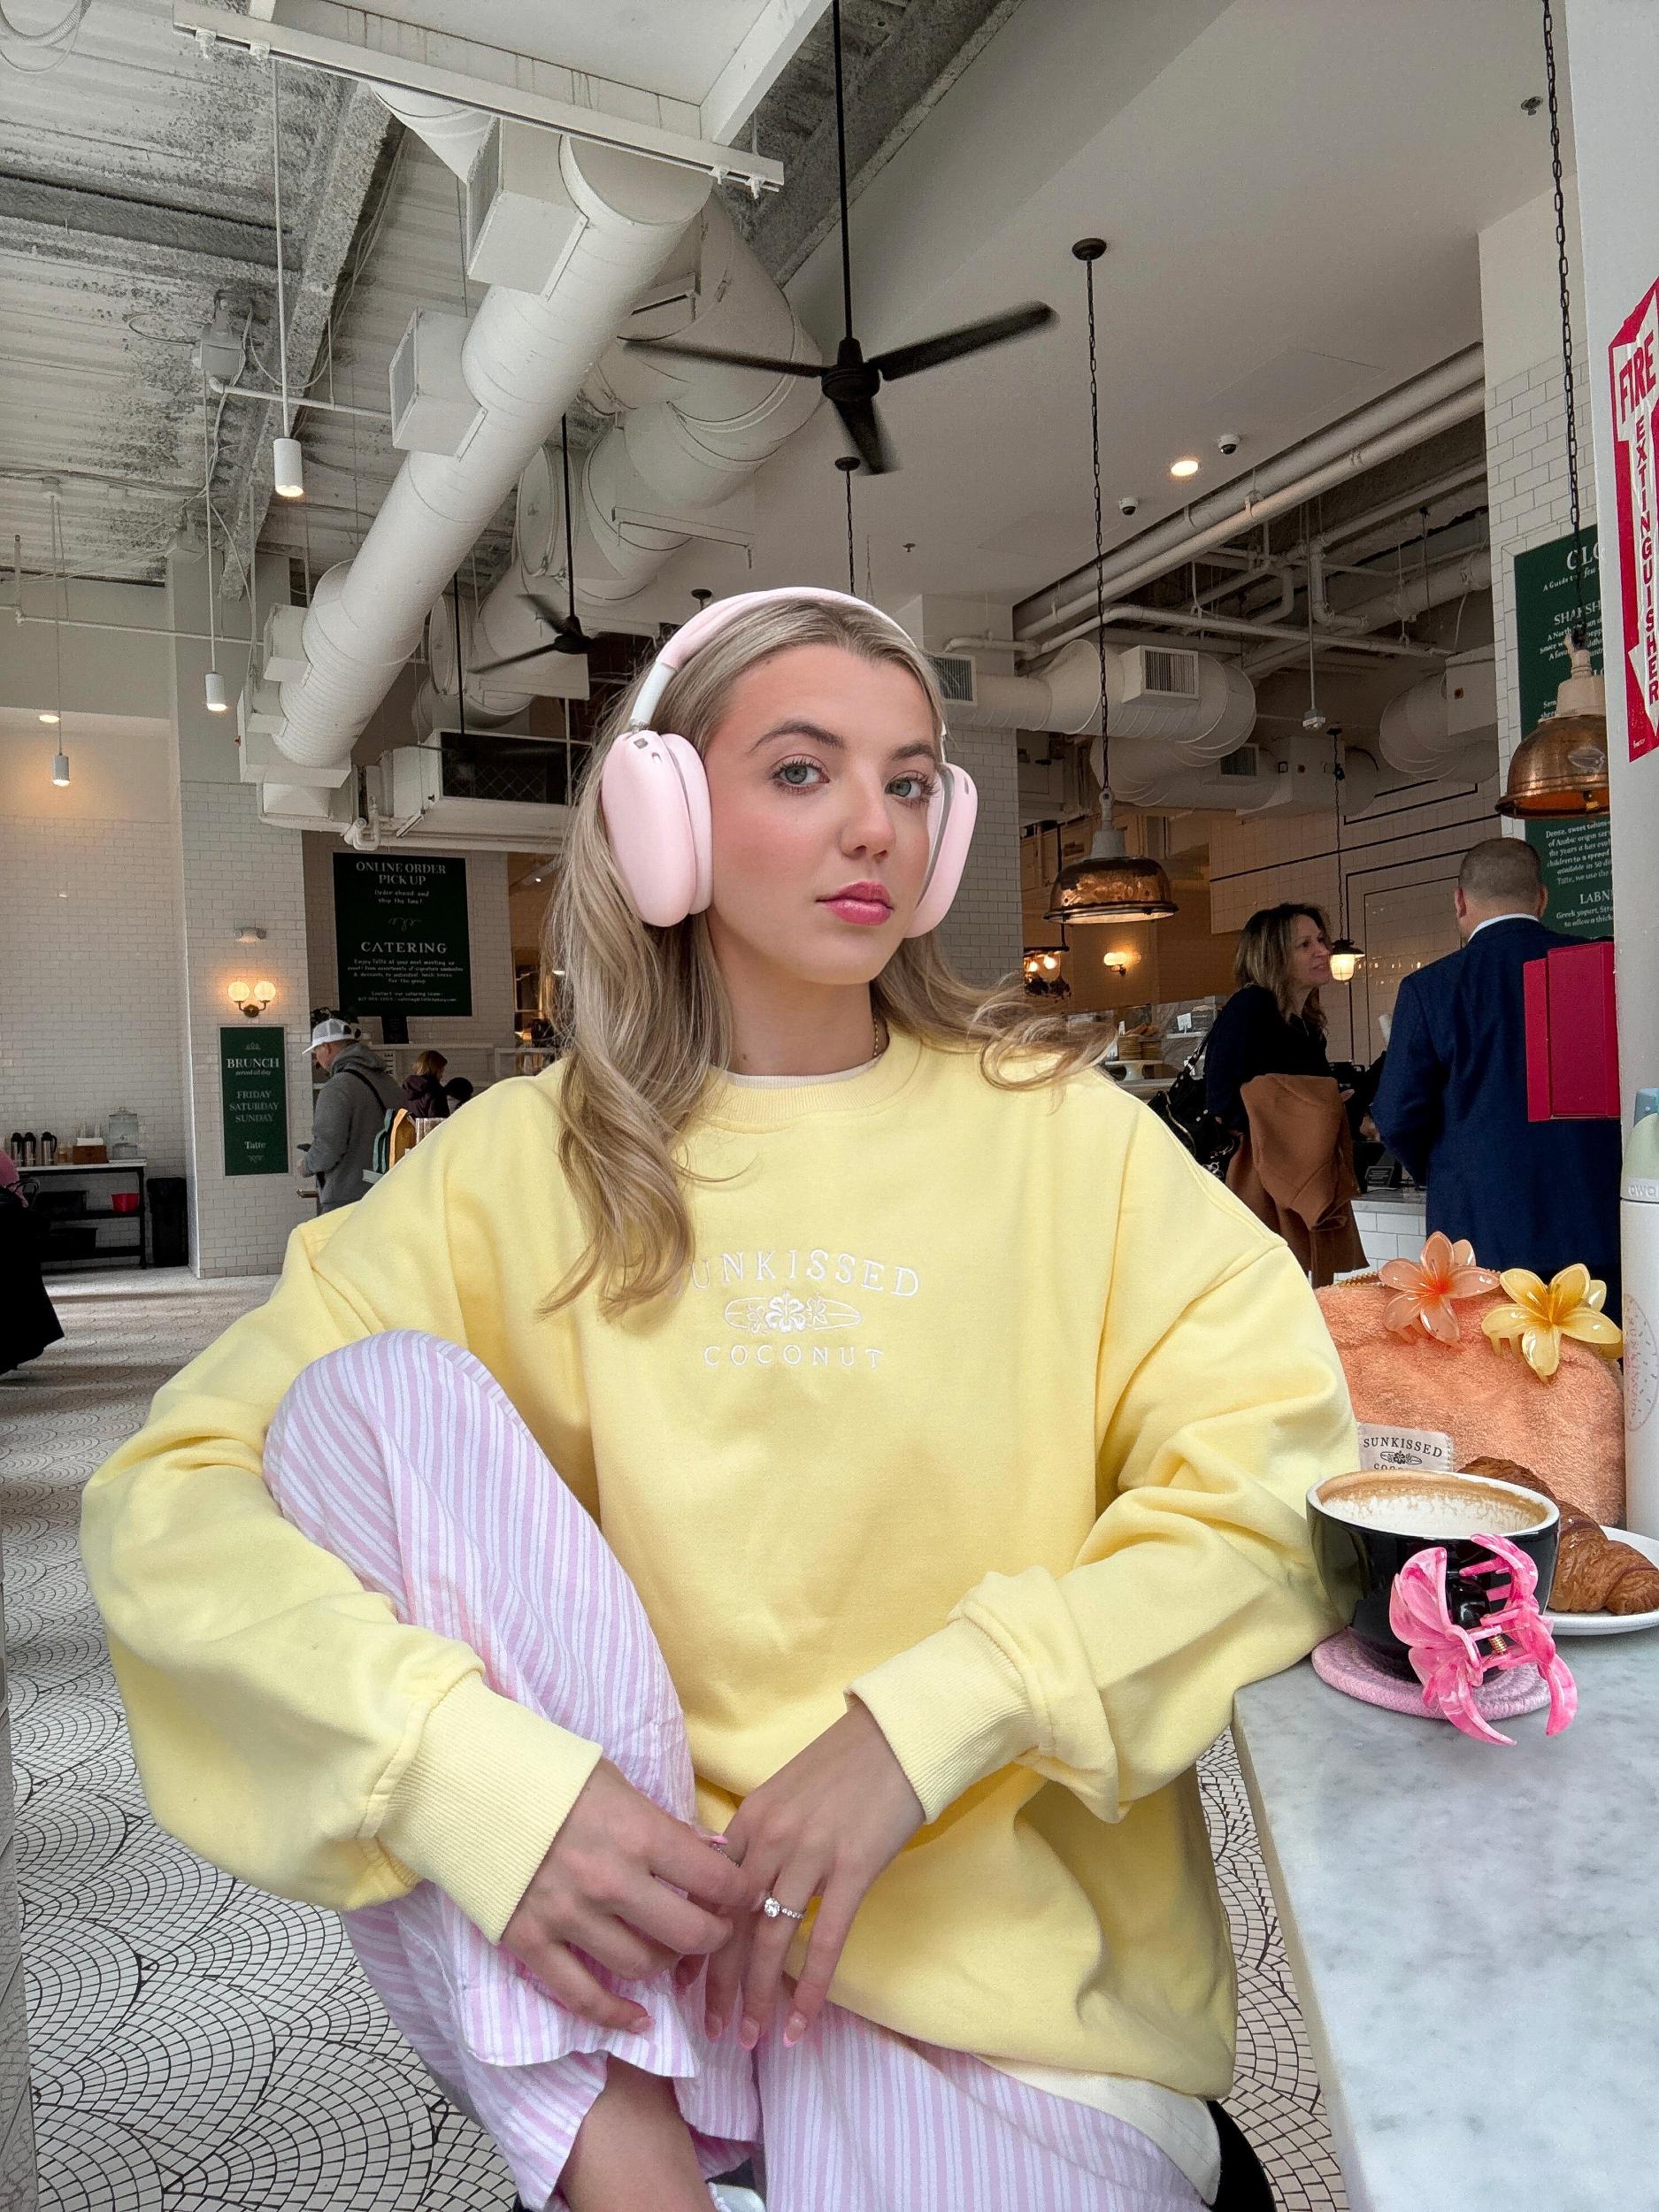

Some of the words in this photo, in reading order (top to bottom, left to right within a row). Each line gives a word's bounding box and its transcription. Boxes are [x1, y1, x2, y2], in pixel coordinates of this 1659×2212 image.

[1619, 329, 1656, 426] FIRE
[1549, 577, 1569, 589] Guide
[1584, 567, 1596, 579] few
[1568, 825, 1586, 833] sweet
[1578, 833, 1597, 841] origin
[1587, 849, 1609, 861] spread
[356, 861, 403, 872] ONLINE
[404, 863, 446, 874] ORDER
[379, 874, 407, 885] PICK
[410, 876, 426, 886] UP
[1556, 909, 1576, 919] Greek
[360, 941, 447, 954] CATERING
[227, 1057, 280, 1069] BRUNCH
[237, 1090, 272, 1099] FRIDAY
[229, 1102, 279, 1111] SATURDAY
[234, 1113, 274, 1123] SUNDAY
[666, 1248, 920, 1298] UNKISSED
[703, 1344, 884, 1368] COCONUT
[1363, 1437, 1443, 1457] SUNKISSED
